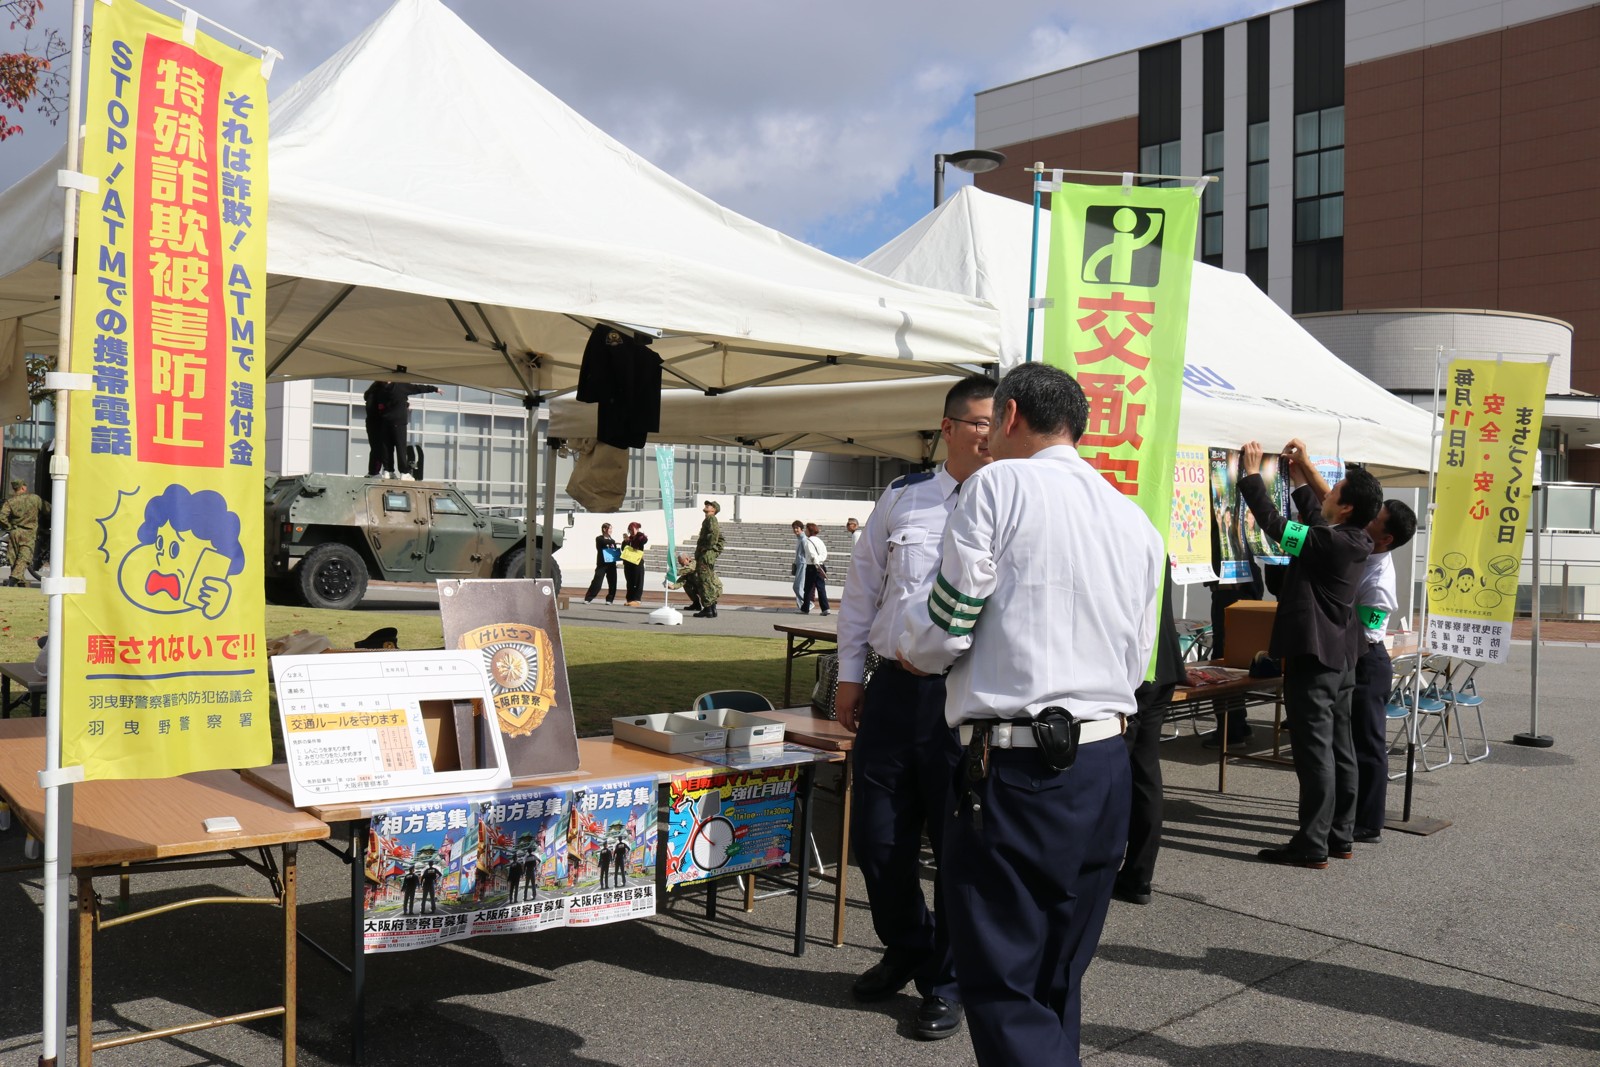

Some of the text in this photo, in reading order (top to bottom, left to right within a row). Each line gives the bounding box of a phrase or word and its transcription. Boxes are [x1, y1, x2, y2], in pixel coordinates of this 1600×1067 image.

[91, 40, 133, 456] STOP!ATMでの携帯電話
[149, 59, 208, 448] 特殊詐欺被害防止
[480, 627, 532, 643] けいさつ
[86, 633, 256, 665] 騙されないで!!
[88, 689, 253, 710] 羽曳野警察署管内防犯協議会
[88, 712, 252, 735] 羽曳野警察署
[291, 713, 405, 730] 交通ルールを守ります。
[580, 787, 650, 811] 相方募集
[731, 781, 792, 801] 強化月間
[380, 808, 467, 835] 相方募集
[488, 797, 562, 824] 相方募集
[570, 886, 653, 908] 大阪府警察官募集
[474, 899, 565, 922] 大阪府警察官募集
[364, 914, 468, 932] 大阪府警察官募集
